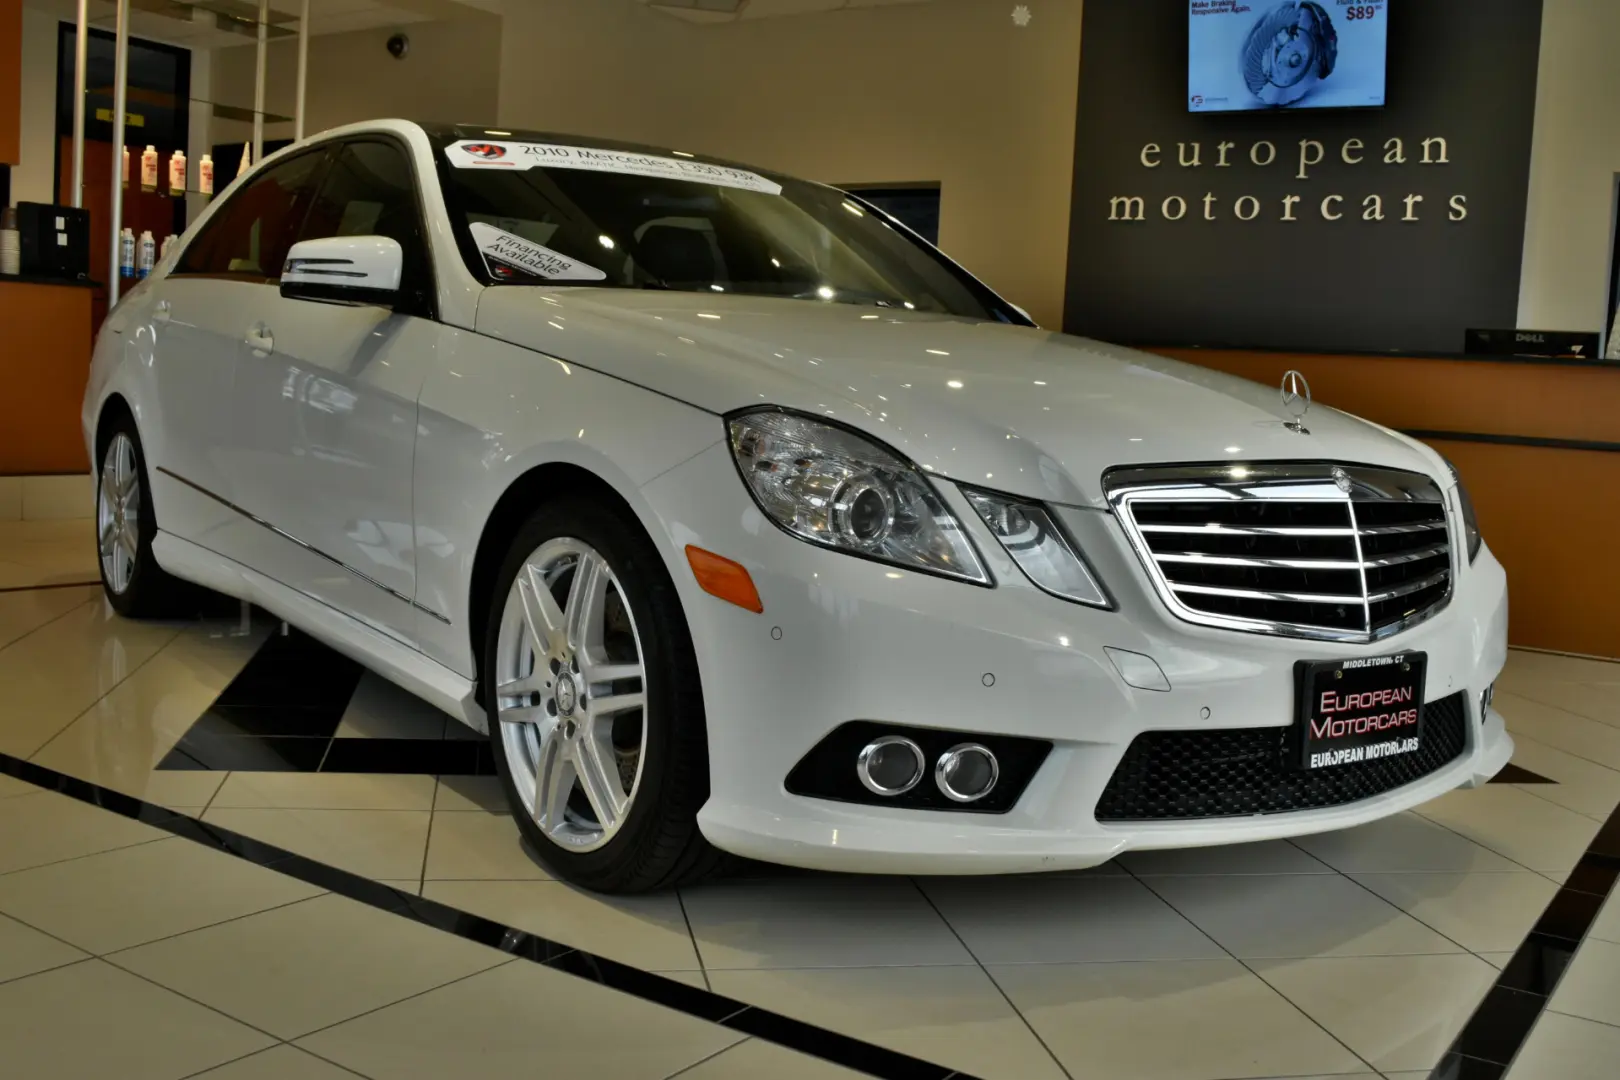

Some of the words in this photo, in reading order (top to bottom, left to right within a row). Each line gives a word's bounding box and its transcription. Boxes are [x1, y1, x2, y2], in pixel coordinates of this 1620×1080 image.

[519, 145, 569, 157] 2010
[576, 149, 673, 168] Mercedes
[1139, 135, 1450, 179] european
[1107, 191, 1468, 222] motorcars
[486, 243, 561, 275] Available
[495, 235, 572, 271] Financing
[1515, 333, 1545, 343] DELL
[1394, 655, 1405, 664] CT
